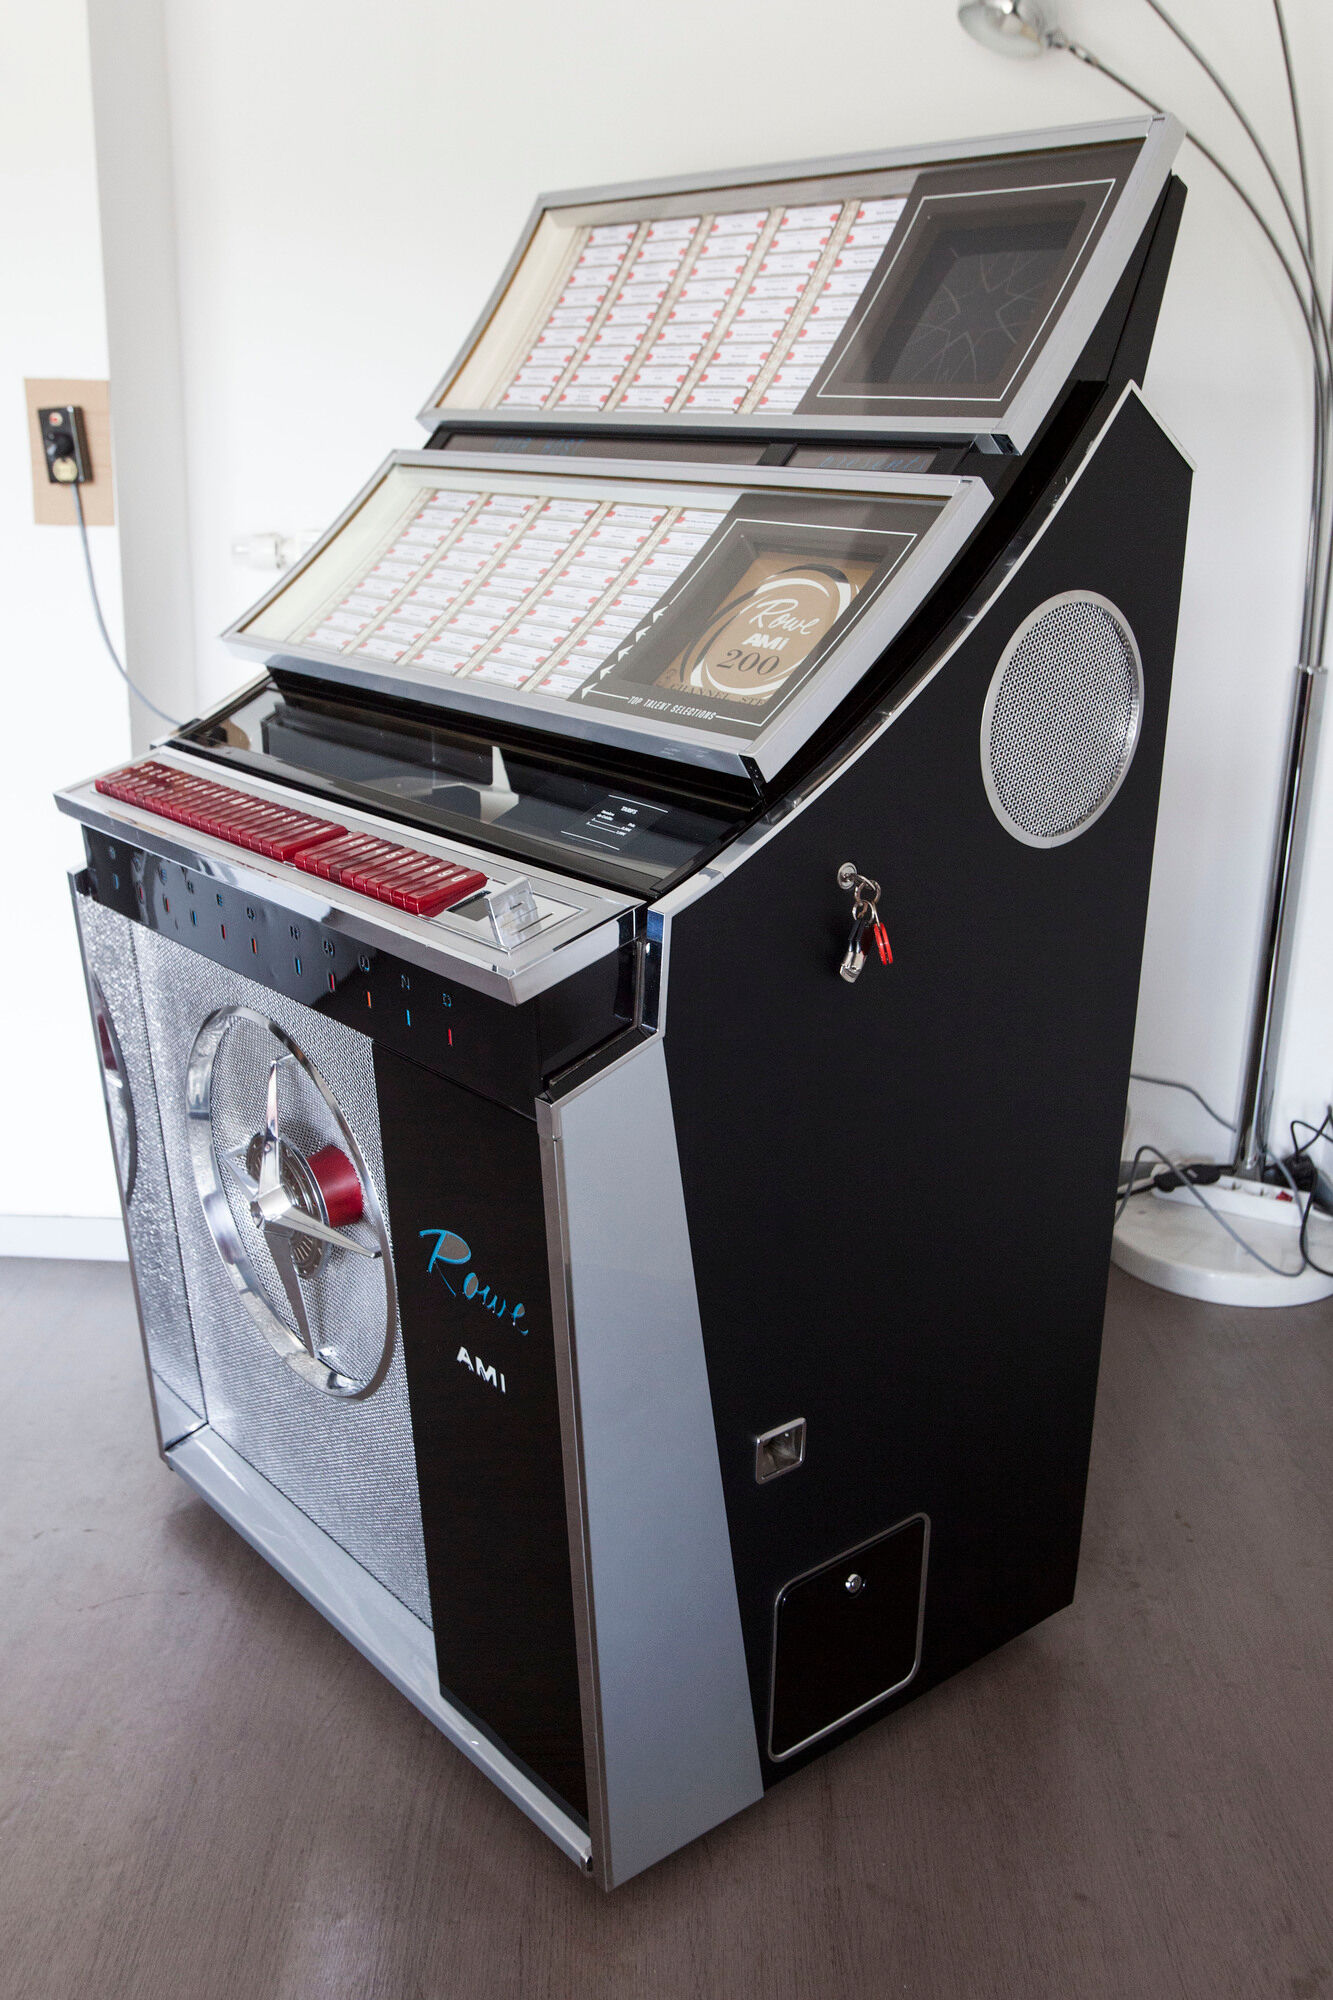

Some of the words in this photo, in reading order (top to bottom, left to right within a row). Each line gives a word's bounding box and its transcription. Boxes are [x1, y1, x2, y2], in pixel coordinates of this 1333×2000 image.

[749, 599, 820, 635] Rowe
[742, 633, 790, 650] AMI
[716, 648, 781, 676] 200
[628, 695, 643, 705] TOP
[643, 698, 672, 711] TALENT
[670, 704, 717, 720] SELECTIONS
[385, 851, 402, 859] 5
[398, 856, 414, 864] 6
[411, 860, 427, 868] 7
[423, 865, 440, 873] 8
[437, 869, 454, 878] 9
[451, 874, 467, 882] 0
[418, 1228, 529, 1336] Rowe
[456, 1346, 506, 1394] AMI
